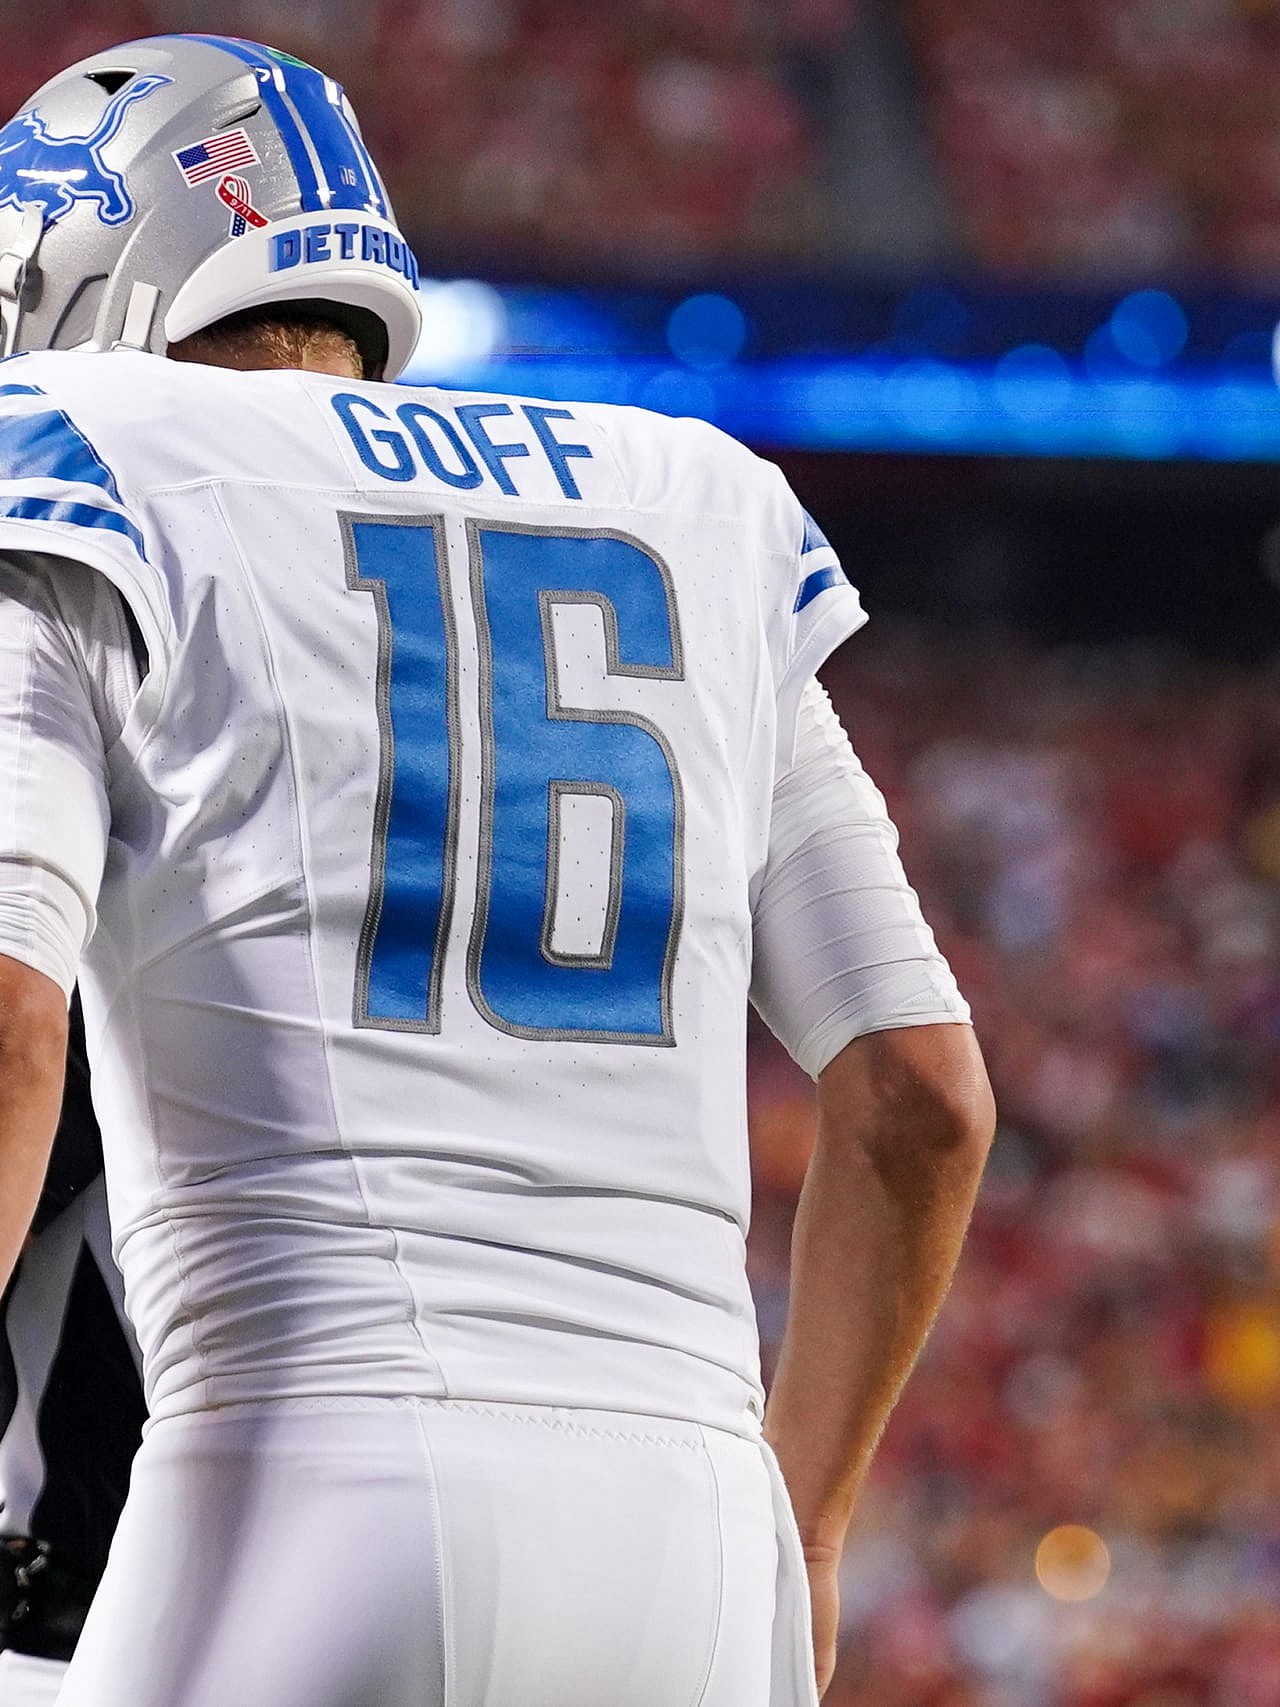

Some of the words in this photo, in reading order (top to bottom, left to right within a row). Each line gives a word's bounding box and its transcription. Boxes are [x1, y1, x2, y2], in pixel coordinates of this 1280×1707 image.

[229, 198, 252, 217] 9/11
[330, 393, 593, 500] GOFF
[337, 510, 685, 1048] 16
